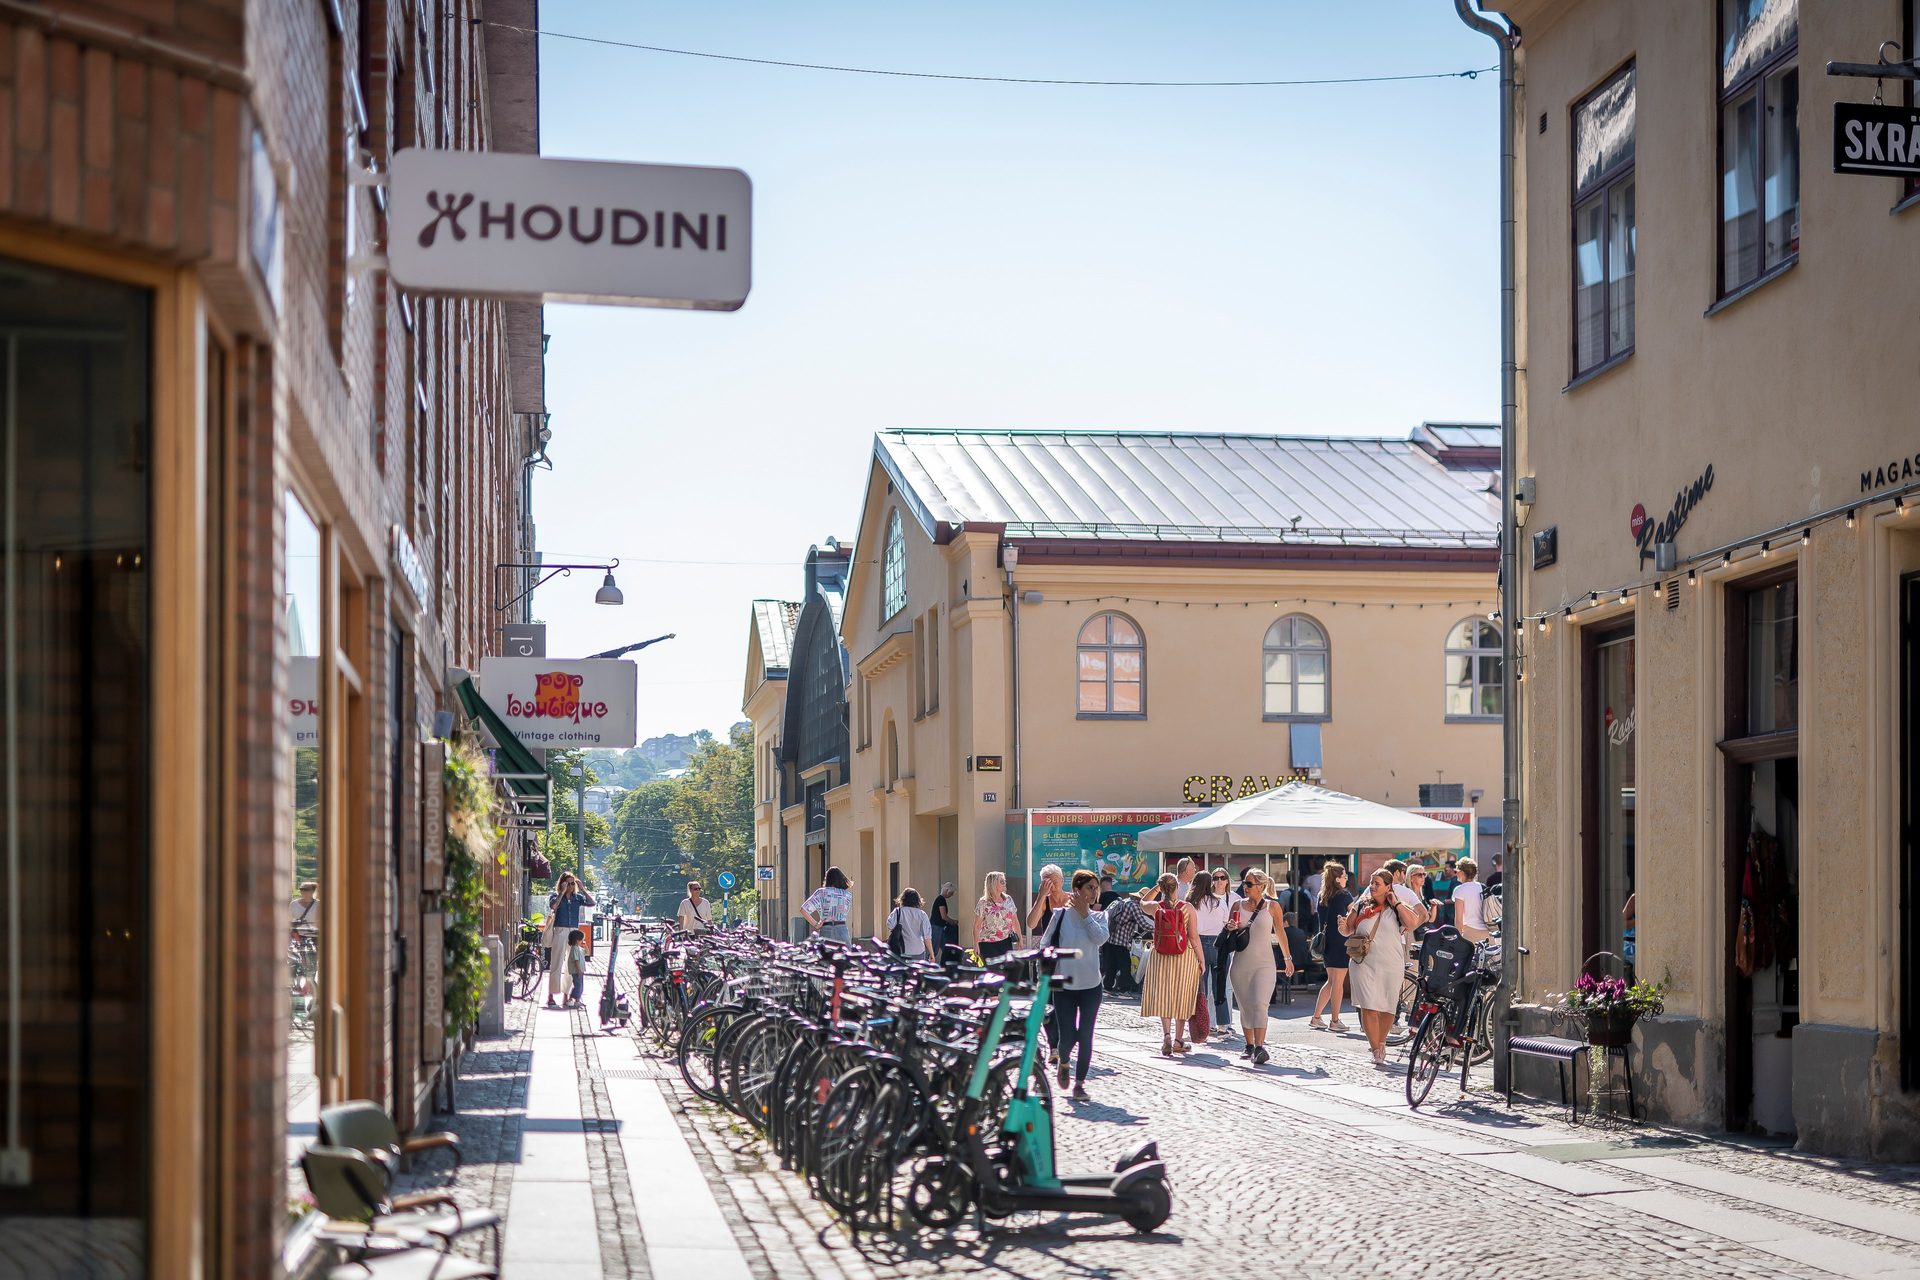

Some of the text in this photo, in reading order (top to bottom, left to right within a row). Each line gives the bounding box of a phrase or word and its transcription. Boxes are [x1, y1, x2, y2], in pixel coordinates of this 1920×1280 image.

[479, 201, 727, 251] HOUDINI
[1631, 515, 1644, 528] miss
[506, 693, 608, 724] boutique
[514, 731, 555, 742] Vintage
[559, 731, 601, 743] clothing
[1183, 775, 1308, 803] CRAV
[427, 771, 440, 847] HOUDINI
[1090, 814, 1124, 823] WRAPS
[1126, 814, 1134, 823] &
[1136, 814, 1161, 823] DOGS
[426, 935, 439, 1009] HOUDINI
